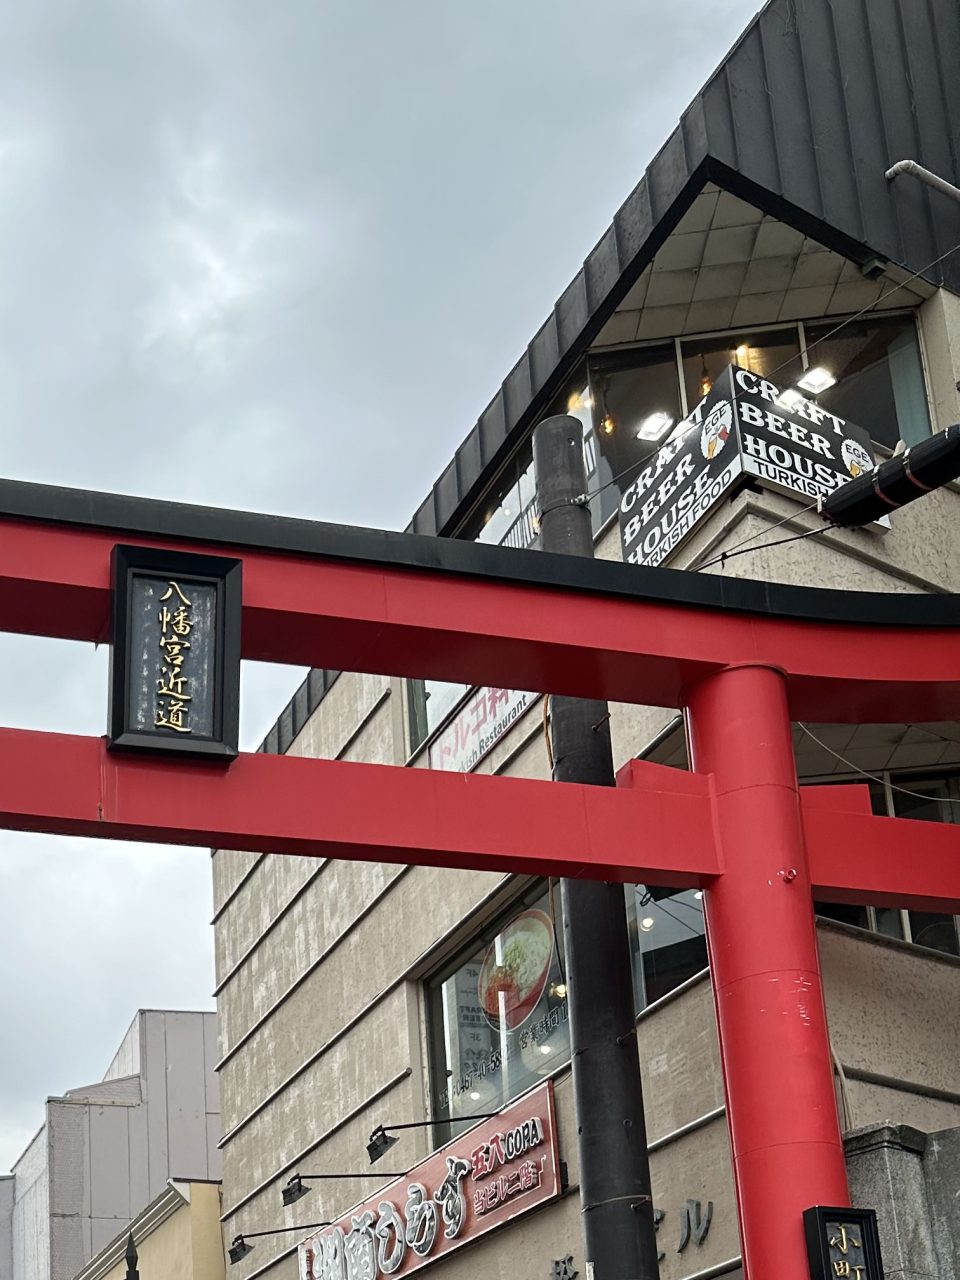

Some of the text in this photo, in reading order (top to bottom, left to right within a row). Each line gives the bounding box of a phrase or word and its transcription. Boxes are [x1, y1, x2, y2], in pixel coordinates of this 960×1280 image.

[704, 407, 728, 435] EGE
[740, 402, 835, 460] BEER
[753, 459, 830, 500] TURKISH
[845, 444, 870, 463] EGE
[624, 453, 696, 547] BEER
[627, 464, 714, 565] HOUSE
[692, 468, 732, 522] FOOD
[155, 581, 193, 733] 八幡宮近道
[478, 693, 528, 755] Restaurant
[518, 1005, 561, 1050] 営業時間
[473, 1160, 538, 1215] 当ビル二階
